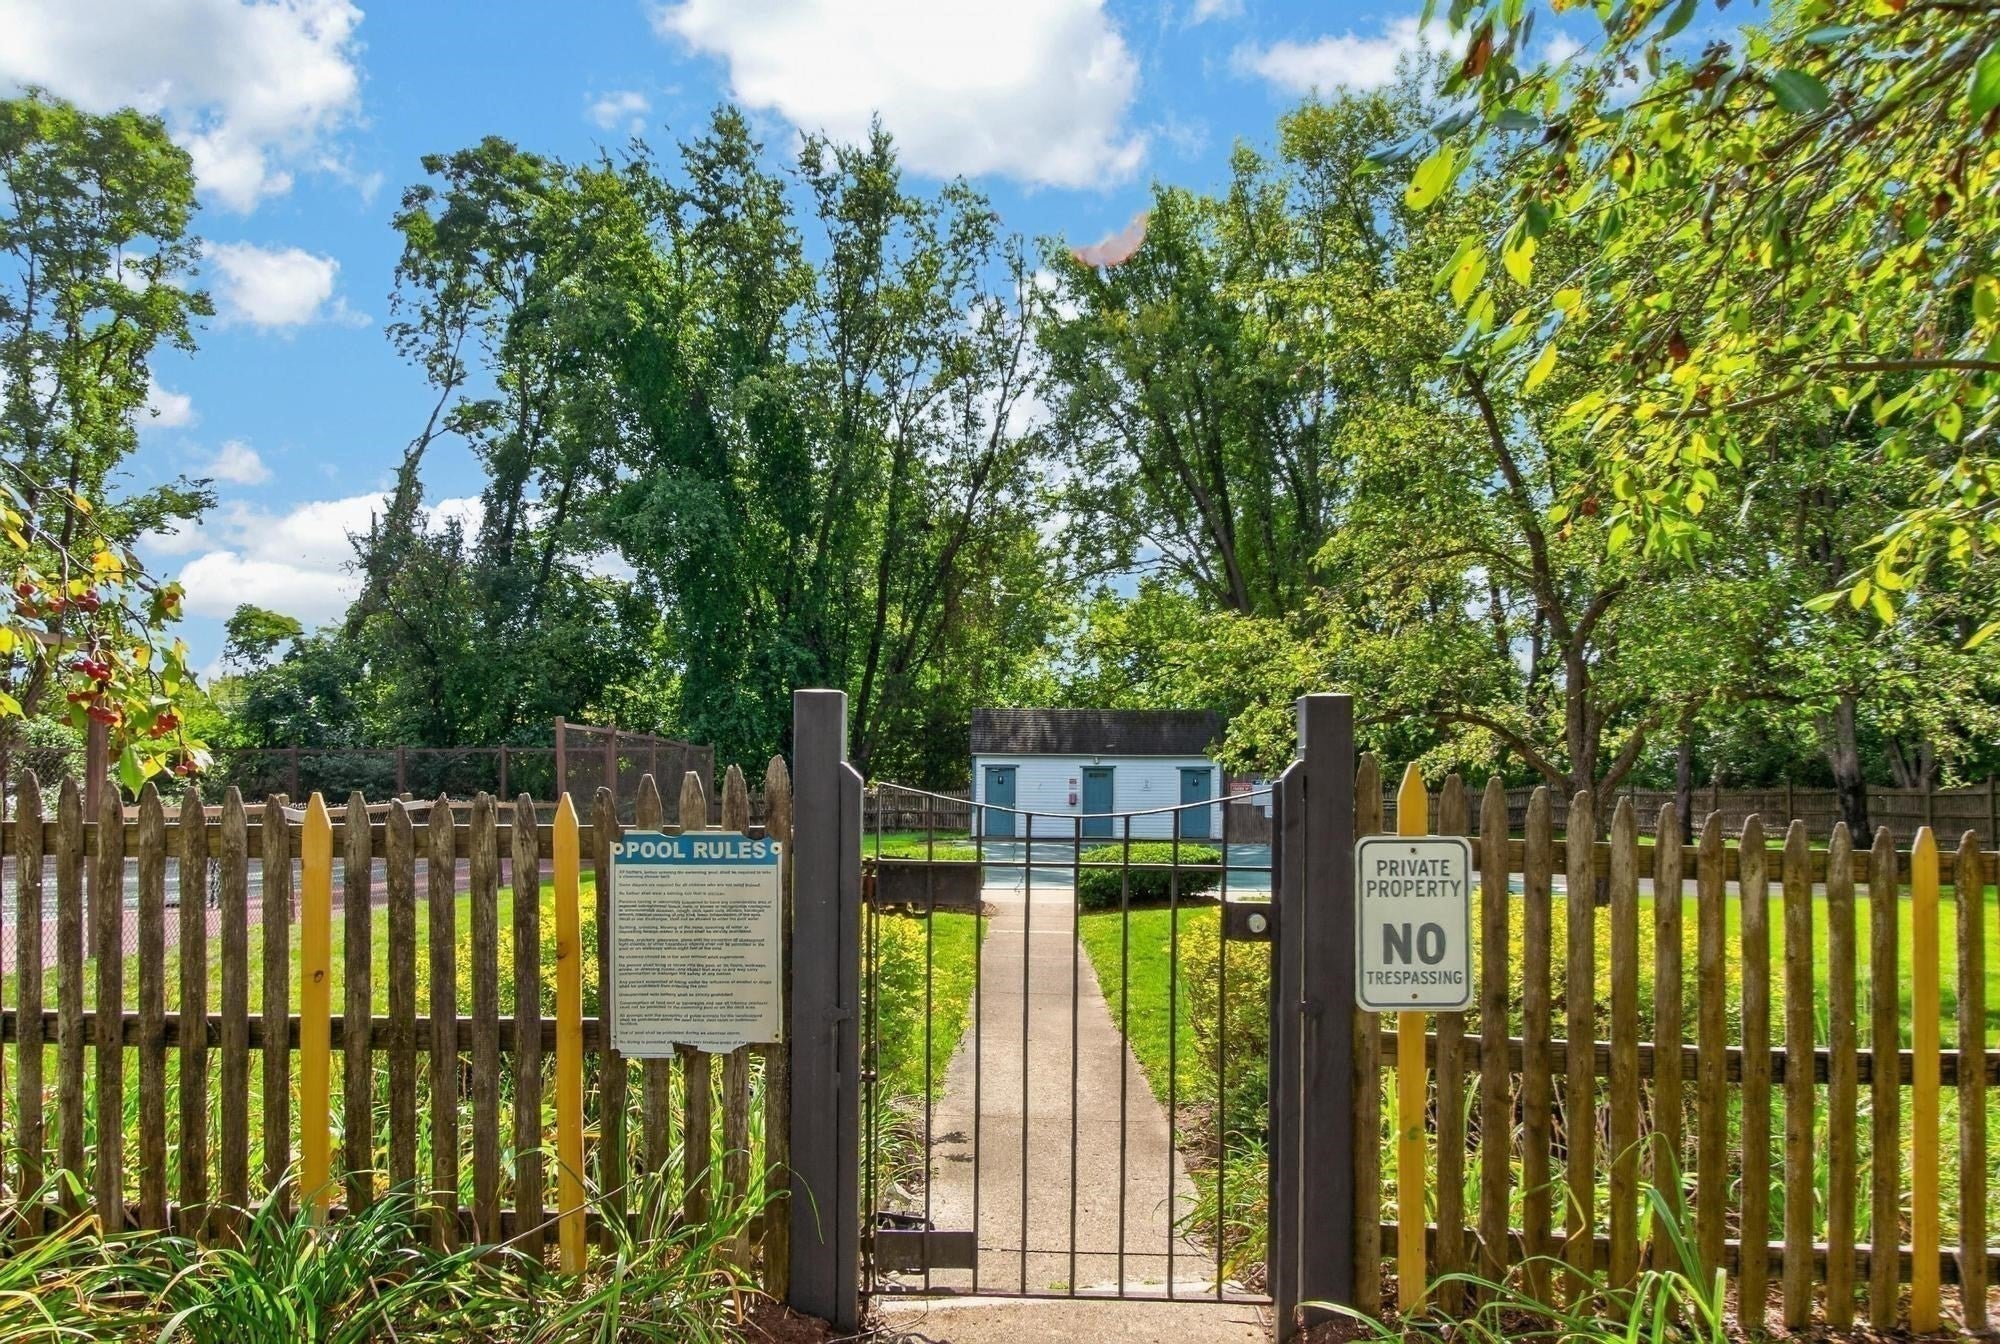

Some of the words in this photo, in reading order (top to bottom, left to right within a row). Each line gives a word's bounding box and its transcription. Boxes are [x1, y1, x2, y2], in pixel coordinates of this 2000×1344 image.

[626, 841, 686, 859] POOL
[693, 841, 767, 859] RULES
[1377, 859, 1450, 877] PRIVATE
[1366, 880, 1462, 898] PROPERTY
[1383, 922, 1446, 965] NO
[1366, 971, 1462, 985] TRESPASSING
